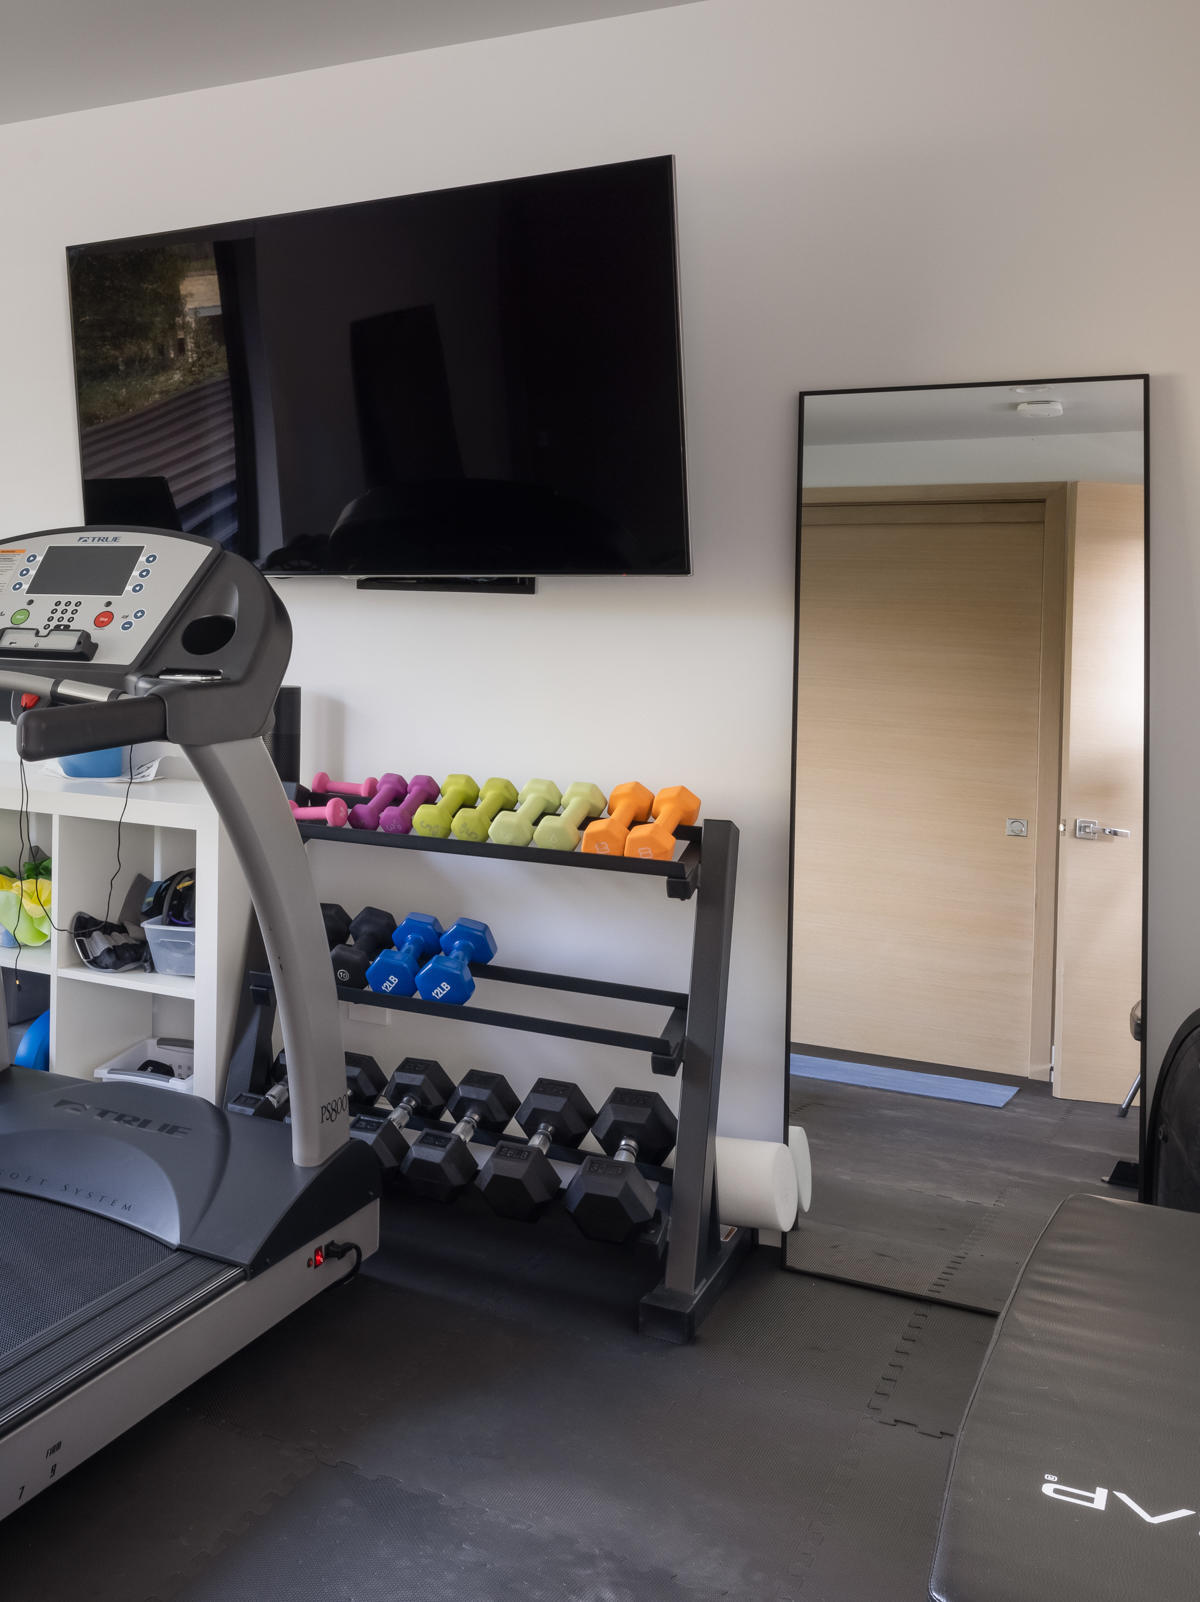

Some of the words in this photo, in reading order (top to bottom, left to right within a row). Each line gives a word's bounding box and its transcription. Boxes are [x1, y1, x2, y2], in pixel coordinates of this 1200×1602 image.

[381, 975, 399, 992] 12LB
[431, 982, 451, 999] 12LB
[95, 1107, 193, 1137] TRUE
[320, 1094, 348, 1124] PS800
[61, 1183, 135, 1211] SYSTEM
